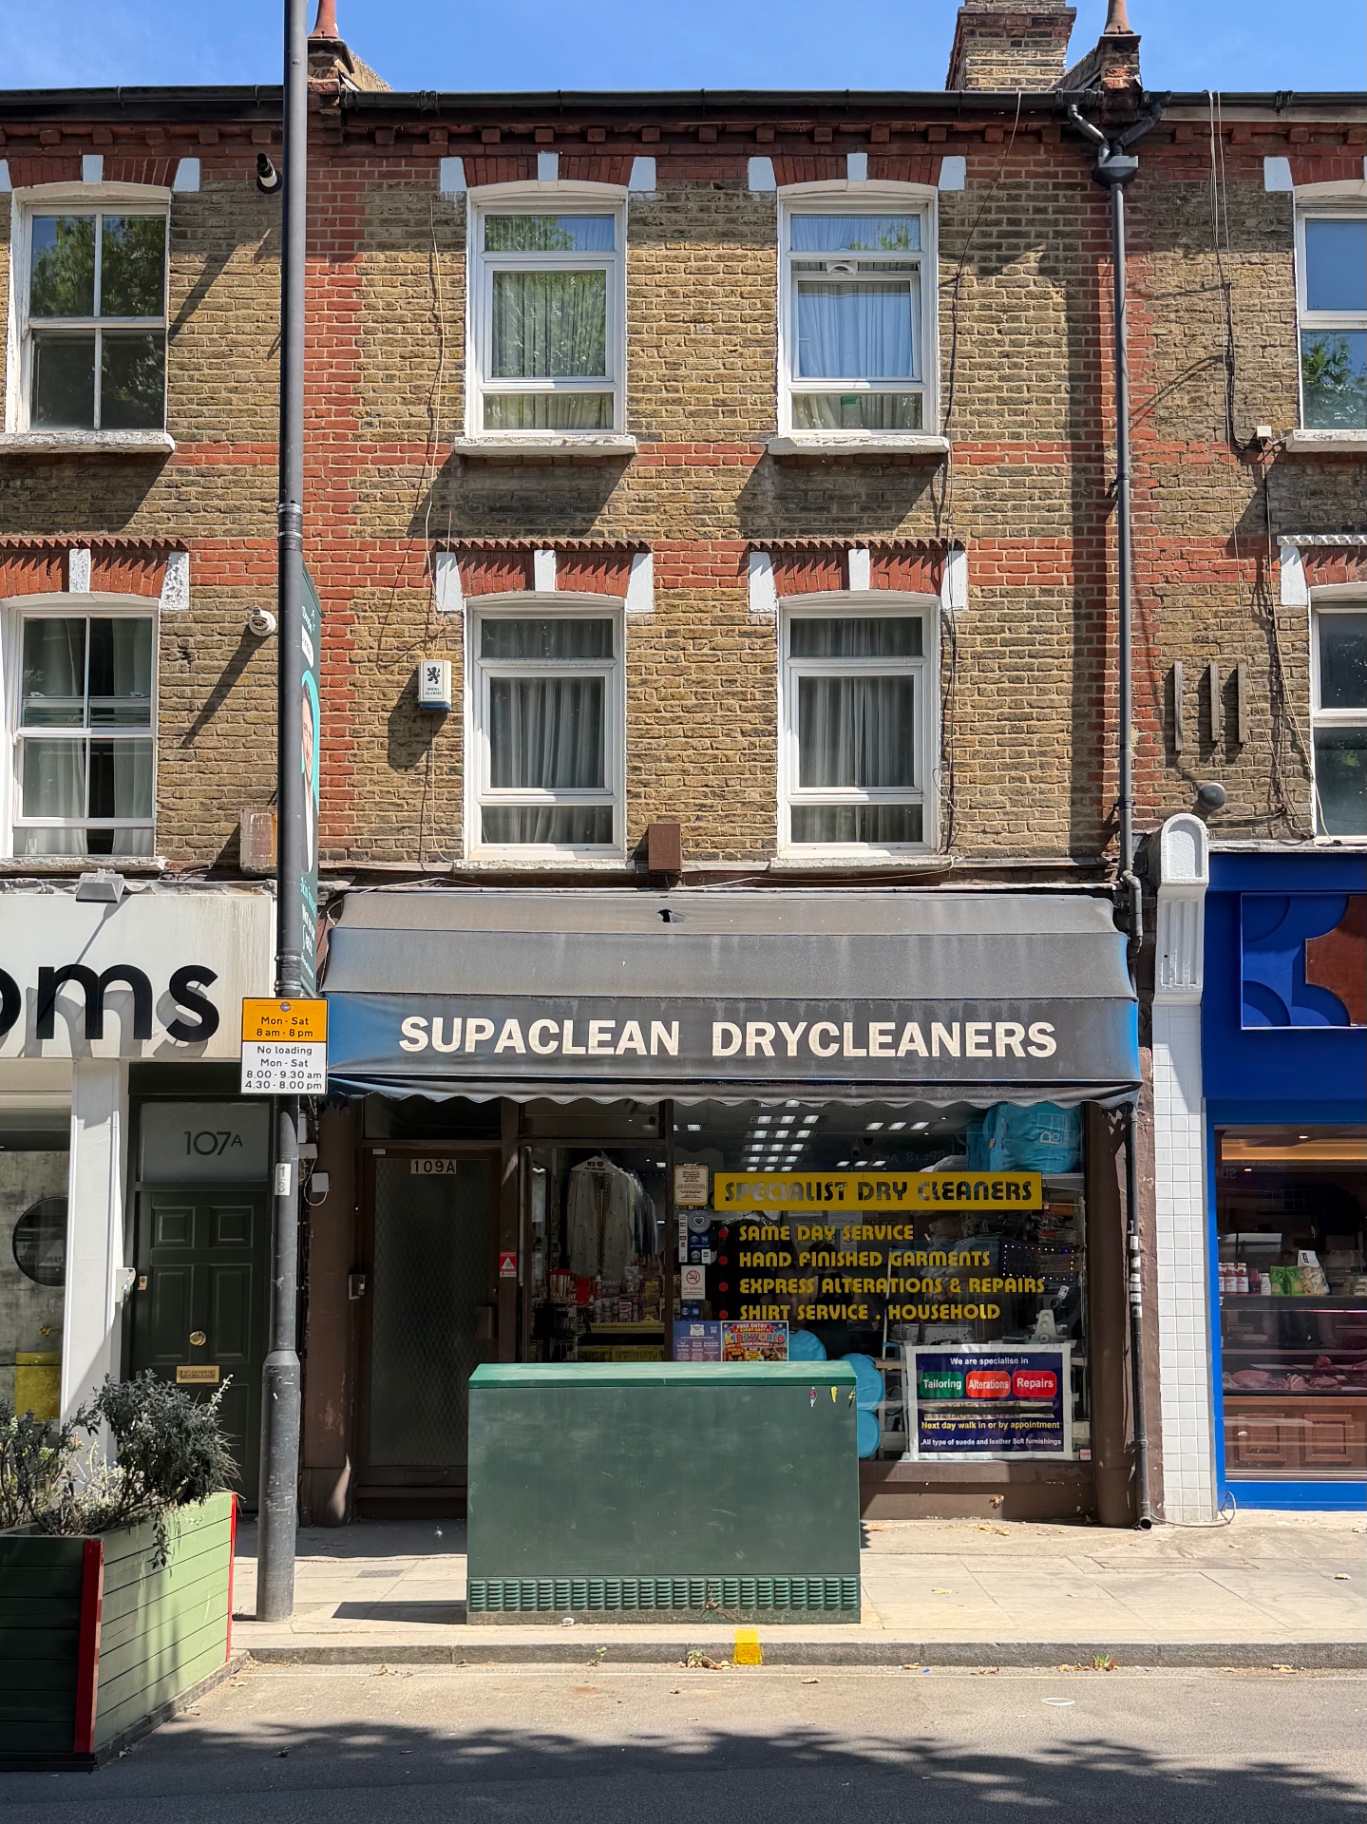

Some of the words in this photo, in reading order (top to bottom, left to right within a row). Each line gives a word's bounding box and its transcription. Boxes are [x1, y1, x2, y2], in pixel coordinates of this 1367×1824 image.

[0, 964, 219, 1042] ms
[261, 1017, 282, 1025] Mon
[291, 1017, 309, 1025] Sat
[298, 1030, 313, 1038] pm
[399, 1016, 679, 1056] SUPACLEAN
[712, 1020, 1057, 1058] DRYCLEANERS
[257, 1046, 271, 1054] No
[275, 1046, 312, 1055] loading
[291, 1059, 308, 1067] Sat
[280, 1071, 304, 1079] 9.30
[245, 1081, 270, 1089] 4.30
[279, 1081, 304, 1089] 8.00
[307, 1082, 321, 1090] pm
[183, 1130, 244, 1156] 107A
[415, 1160, 455, 1173] 109A
[725, 1182, 848, 1202] SPECIALIST
[857, 1182, 908, 1201] DRY
[918, 1181, 1032, 1201] CLEANERS
[739, 1225, 790, 1241] SAME
[797, 1225, 836, 1241] DAY
[842, 1225, 914, 1241] SERVICE
[739, 1252, 792, 1268] HAND
[799, 1251, 883, 1267] FINISHED
[889, 1251, 990, 1267] GARMENTS
[739, 1278, 815, 1294] EXPRESS
[821, 1278, 944, 1294] ALTERATIONS
[950, 1278, 961, 1294] &
[968, 1277, 1045, 1293] REPAIRS
[739, 1304, 790, 1320] SHIRT
[797, 1304, 868, 1320] SERVICE
[889, 1304, 1001, 1320] HOUSEHOLD
[979, 1357, 1019, 1366] specialise
[923, 1379, 962, 1390] Tailoring
[968, 1379, 1009, 1390] Alterations
[1017, 1378, 1053, 1389] Repairs
[942, 1422, 955, 1430] day
[998, 1422, 1008, 1430] by
[1011, 1421, 1060, 1430] appointment
[1026, 1438, 1061, 1446] furnishings
